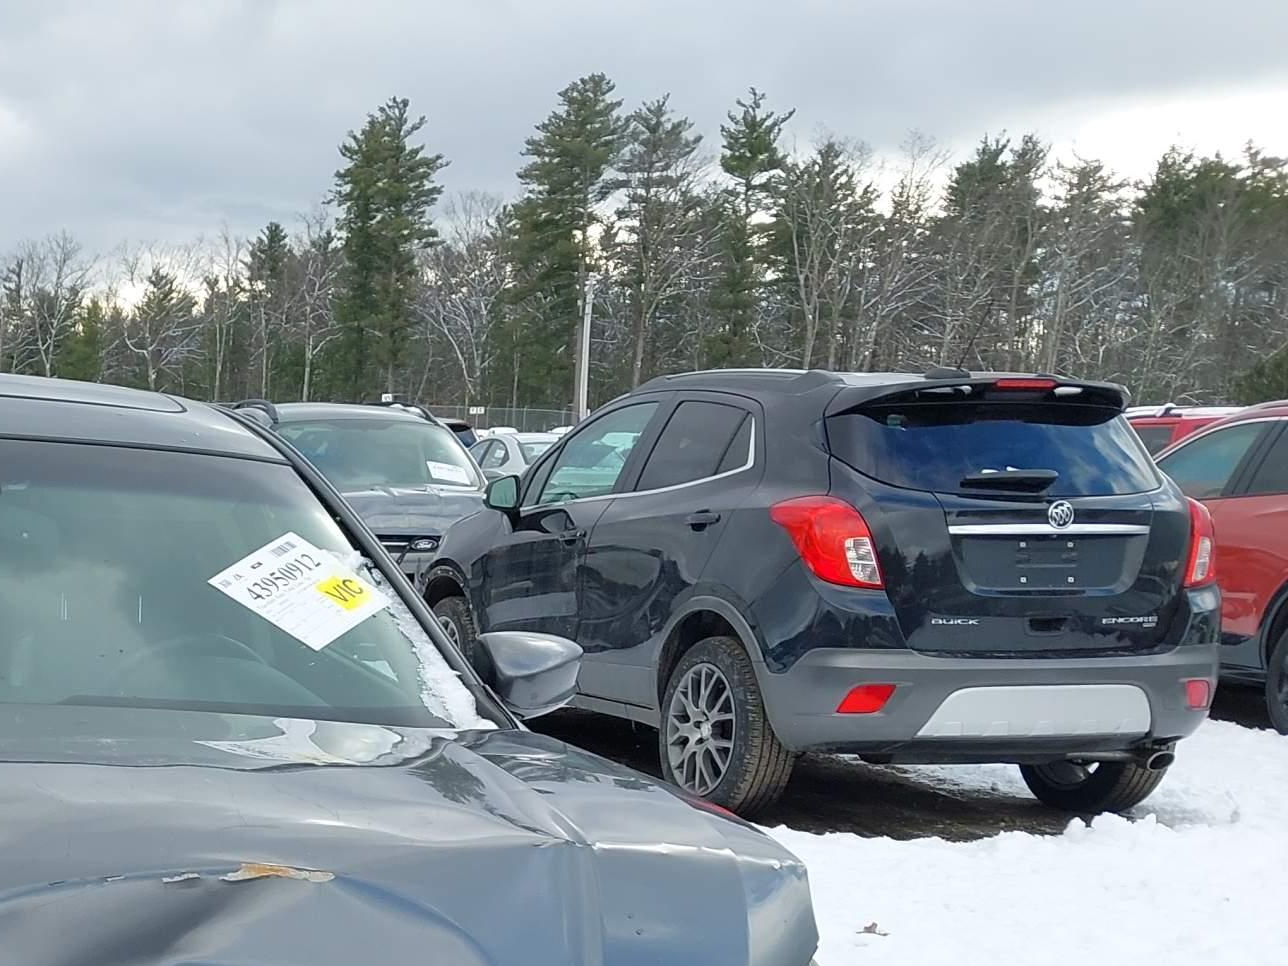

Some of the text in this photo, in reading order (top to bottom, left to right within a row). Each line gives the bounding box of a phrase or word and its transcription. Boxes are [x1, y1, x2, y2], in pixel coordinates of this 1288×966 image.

[246, 553, 321, 600] 43950912
[325, 579, 364, 602] VIC
[1101, 615, 1158, 624] ENCORE
